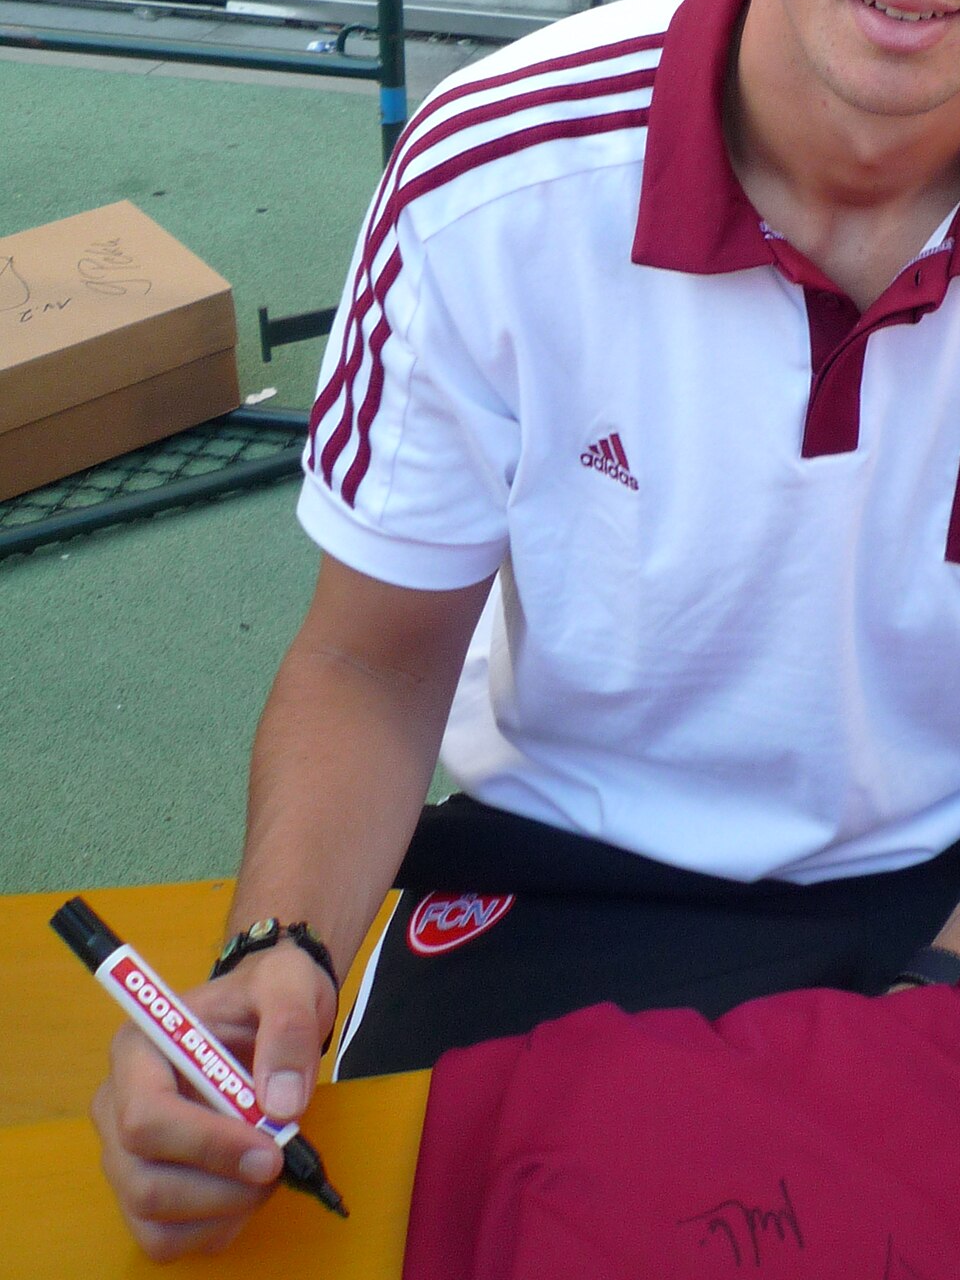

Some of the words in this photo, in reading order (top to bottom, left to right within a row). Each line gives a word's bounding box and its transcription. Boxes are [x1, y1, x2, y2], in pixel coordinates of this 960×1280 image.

[580, 452, 639, 491] adidas
[415, 898, 500, 936] FCN
[124, 969, 184, 1033] 3000
[181, 1028, 256, 1110] edding
